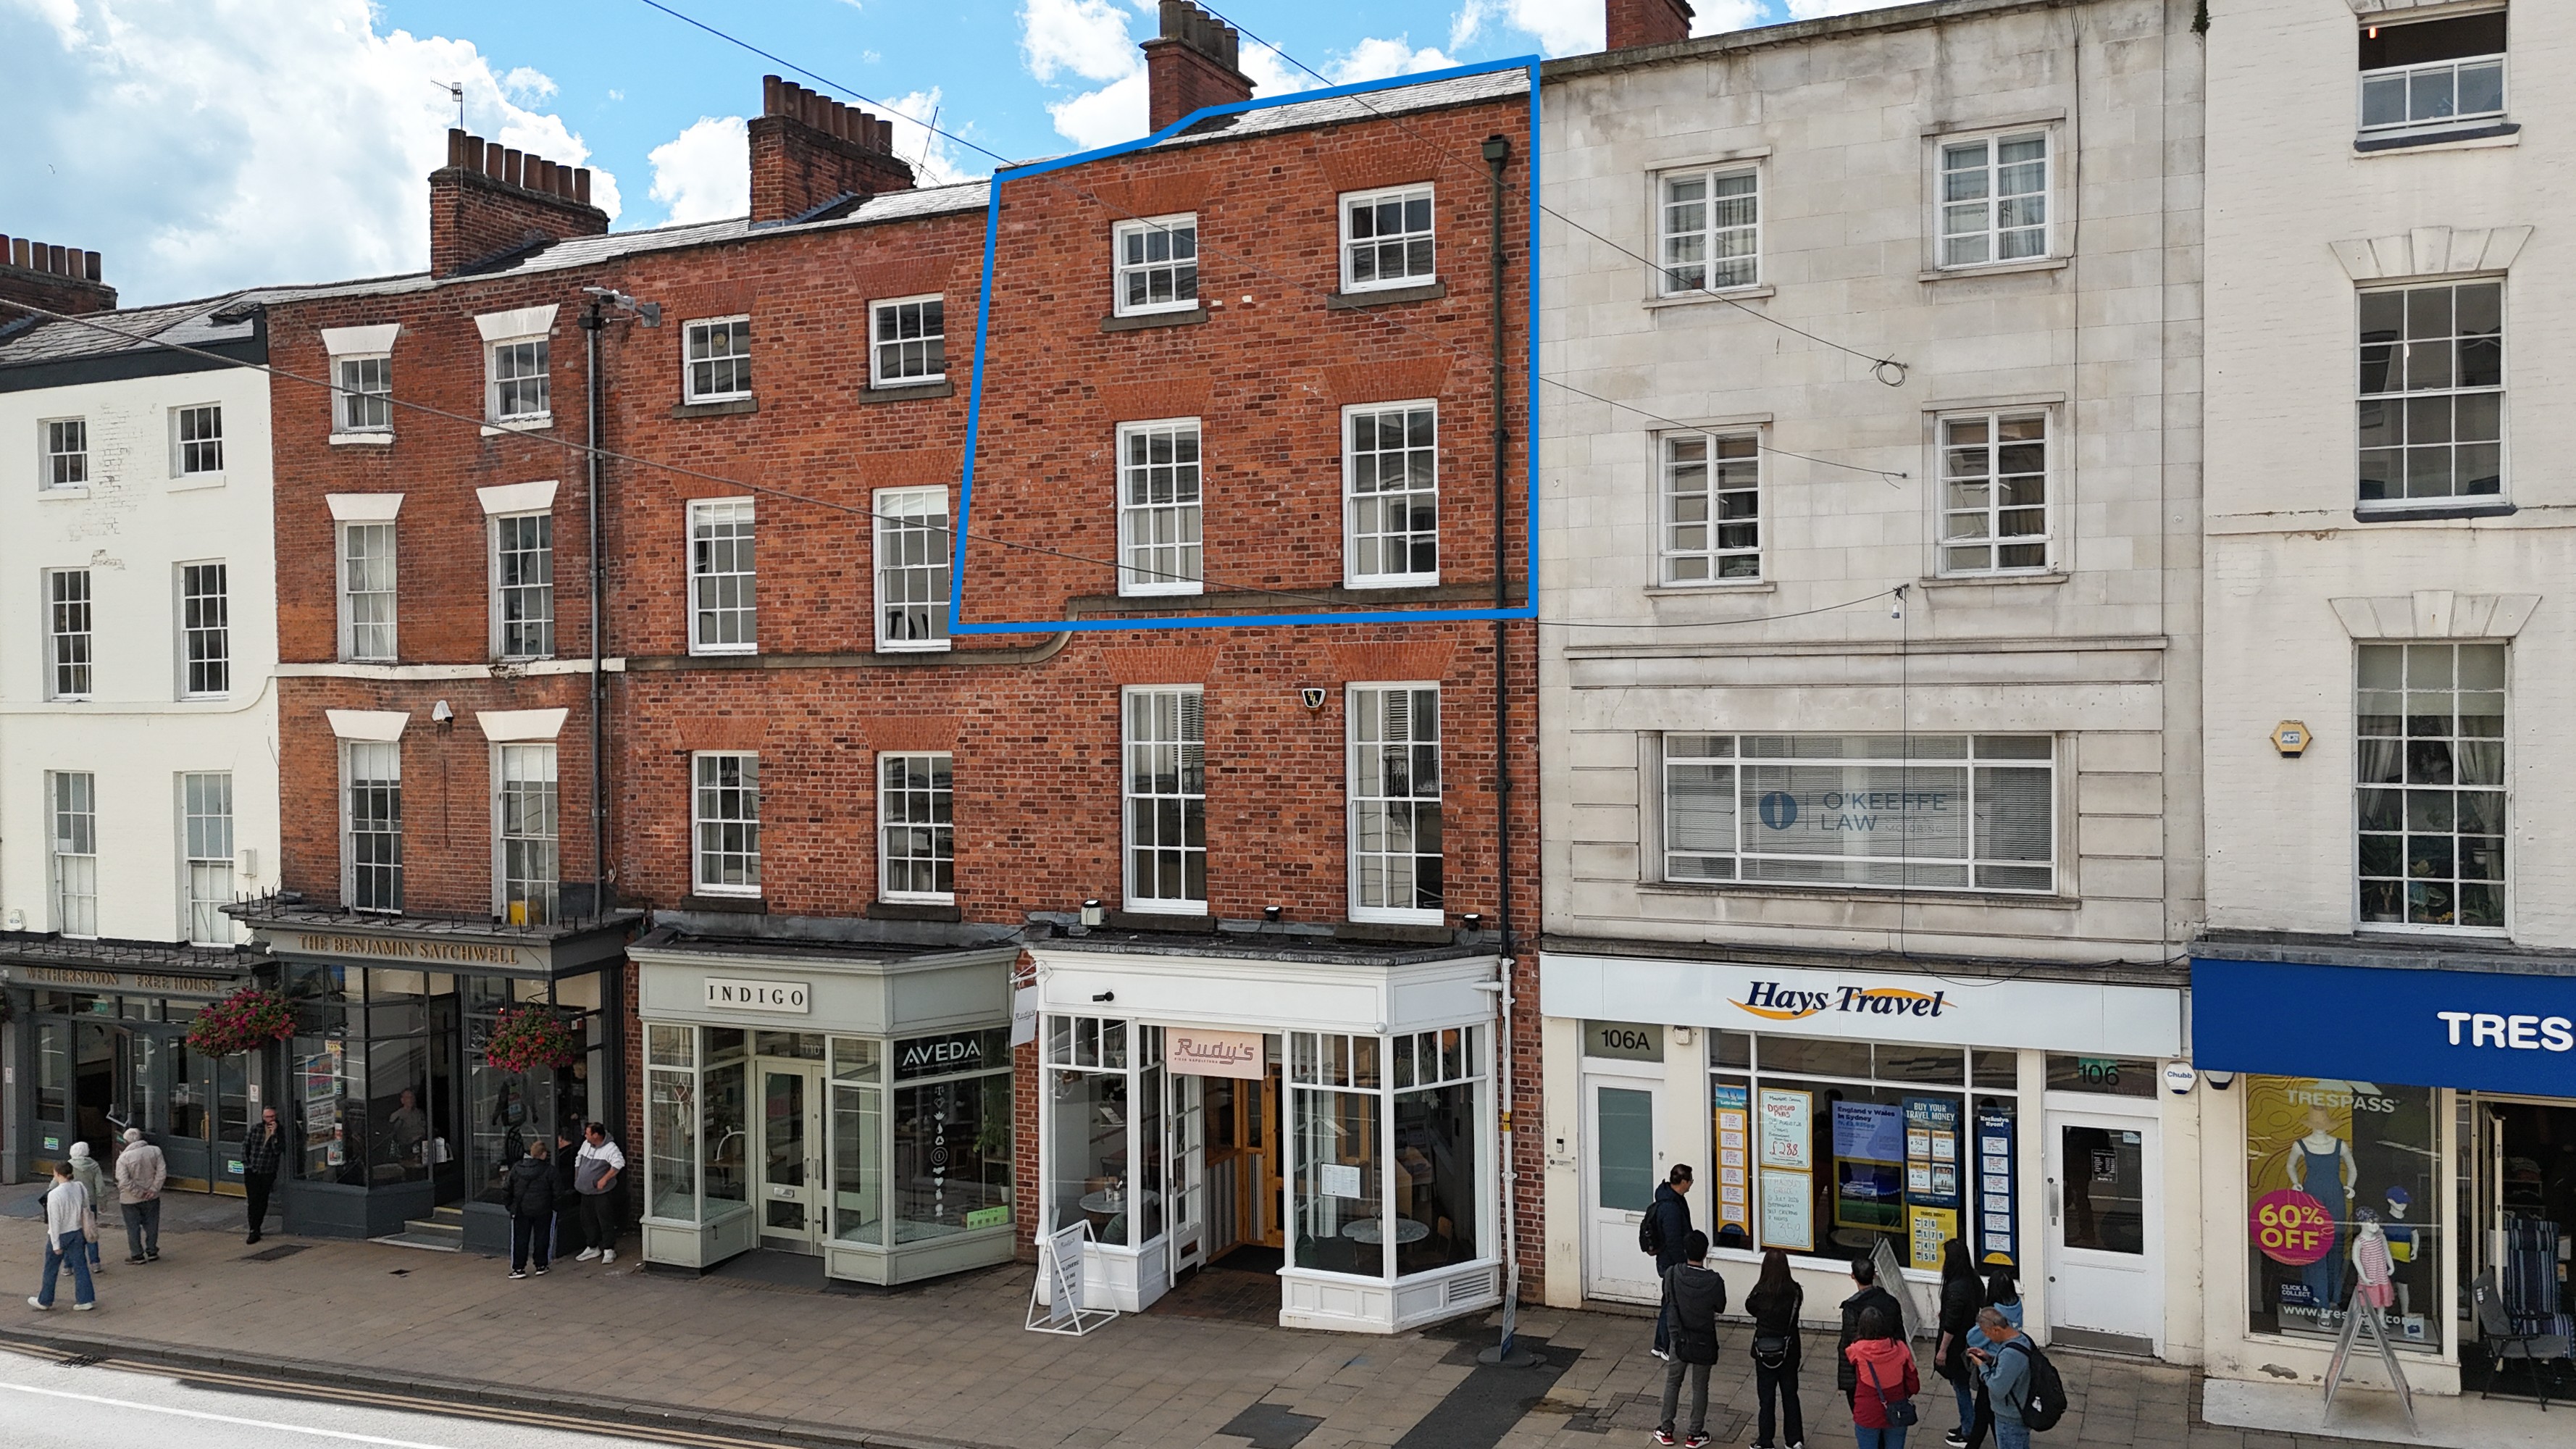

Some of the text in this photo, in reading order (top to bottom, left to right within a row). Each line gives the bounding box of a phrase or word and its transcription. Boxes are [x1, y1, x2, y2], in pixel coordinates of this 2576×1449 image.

[2282, 733, 2300, 742] ADT
[1823, 792, 1947, 811] O'KEEFFE
[1821, 814, 1878, 831] LAW
[298, 935, 519, 965] THE BENJAMIN SATCHWELL
[25, 967, 219, 993] WETHERSPOON FREE HOUSE
[708, 985, 803, 1006] INDIGO
[1744, 981, 1945, 1017] Hays Travel
[1601, 1029, 1651, 1051] 106A
[2436, 1011, 2574, 1051] TRES
[805, 1044, 820, 1055] 110
[902, 1039, 982, 1066] AVEDA
[1174, 1038, 1254, 1065] Rudy's
[2078, 1064, 2120, 1086] 106
[1914, 1102, 1946, 1112] BUY YOUR
[2286, 1089, 2395, 1114] TRESPASS
[1906, 1110, 1955, 1122] TRAVEL MONEY
[2259, 1203, 2325, 1229] 60%
[2260, 1228, 2320, 1250] OFF
